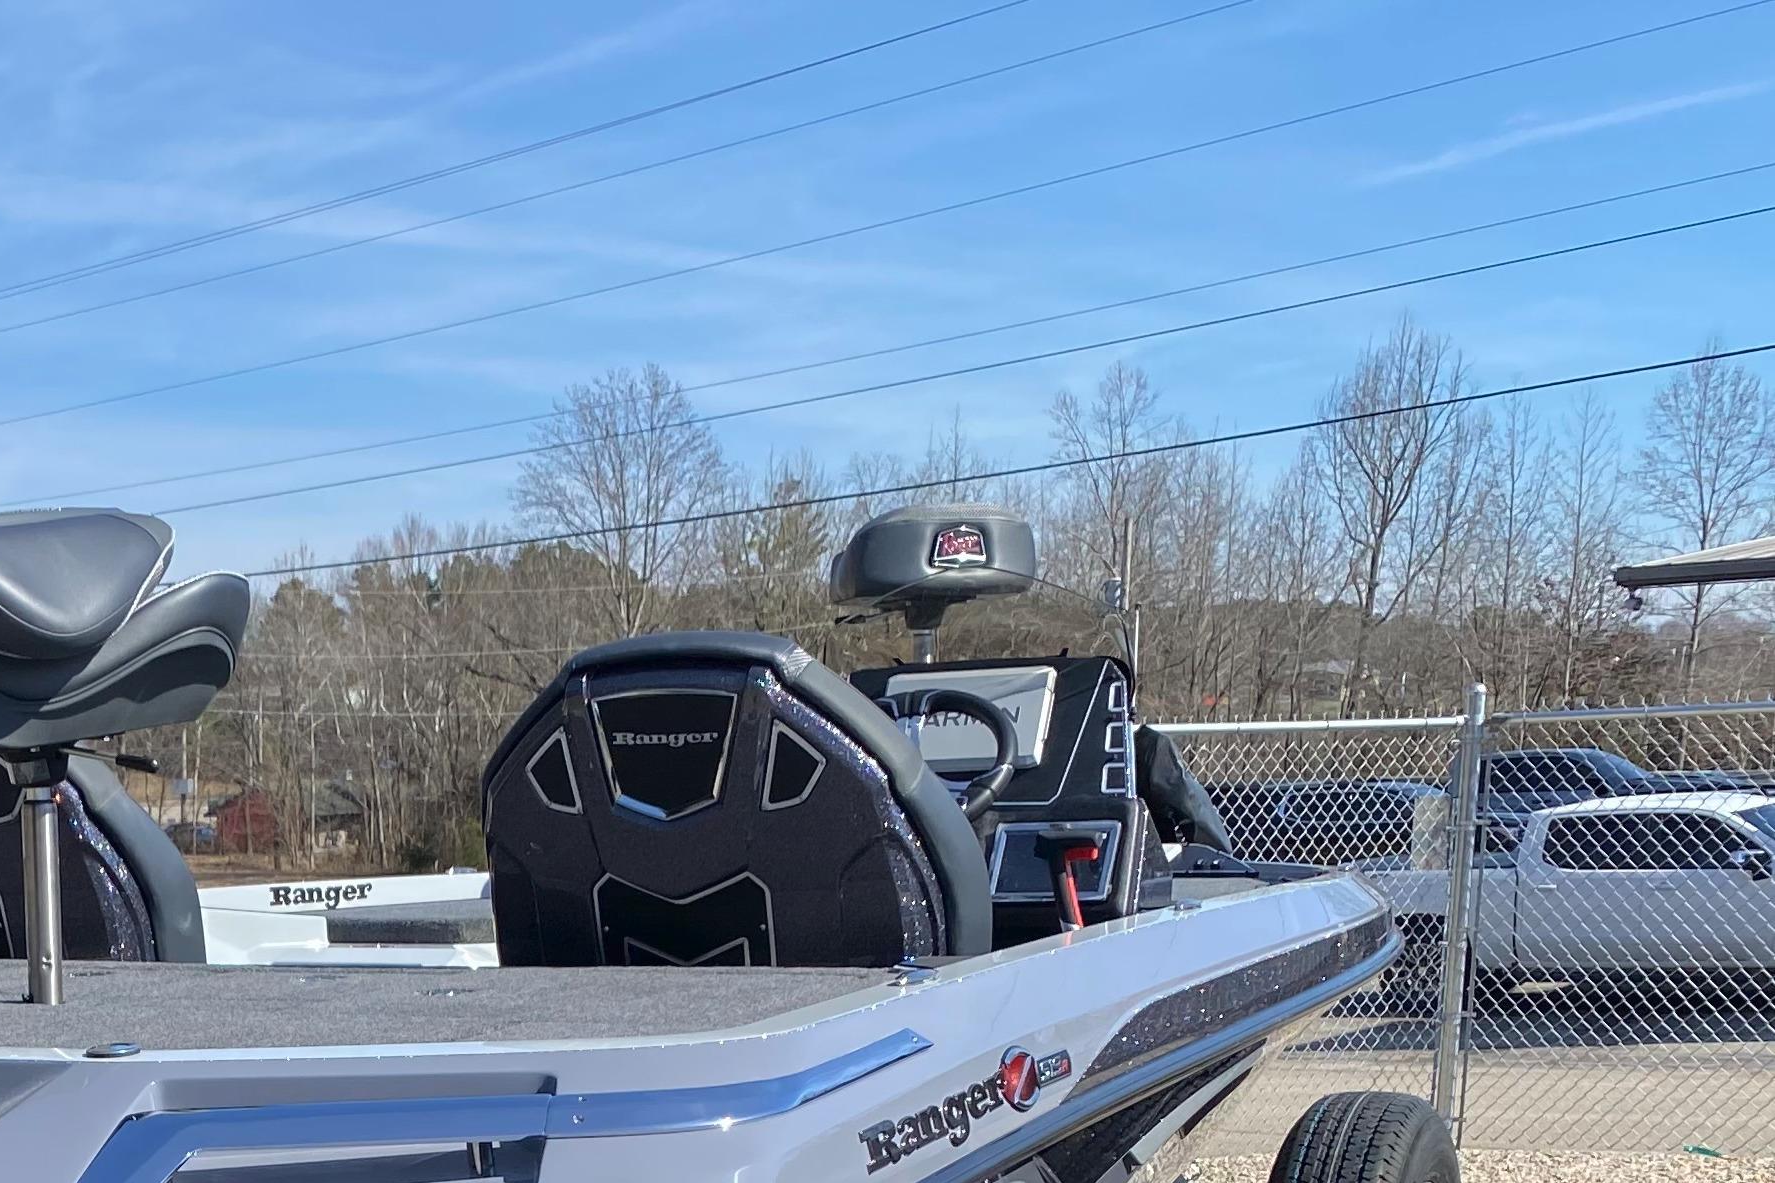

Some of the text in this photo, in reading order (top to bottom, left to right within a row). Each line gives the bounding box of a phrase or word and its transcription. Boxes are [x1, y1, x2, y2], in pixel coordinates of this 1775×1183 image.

[923, 705, 1021, 728] ARMN
[612, 732, 719, 748] Ranger
[269, 882, 373, 911] Ranger
[858, 1068, 1007, 1175] Ranger
